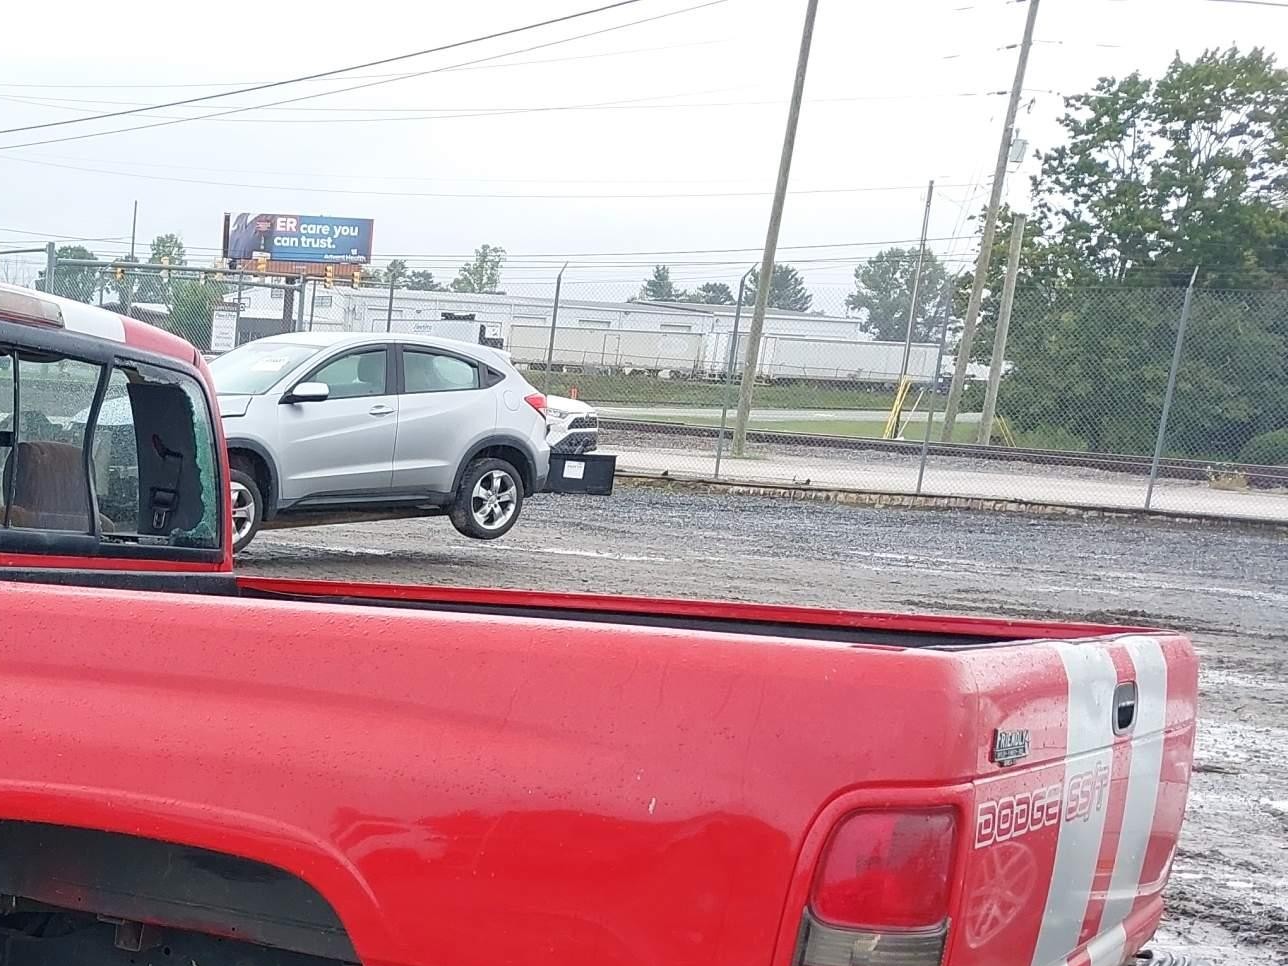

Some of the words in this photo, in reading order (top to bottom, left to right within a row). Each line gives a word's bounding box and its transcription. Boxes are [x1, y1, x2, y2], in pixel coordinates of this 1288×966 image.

[276, 217, 298, 232] ER
[300, 223, 329, 235] care
[333, 225, 359, 238] you
[274, 235, 298, 247] can
[301, 235, 336, 249] trust.
[974, 783, 1062, 849] DODGE
